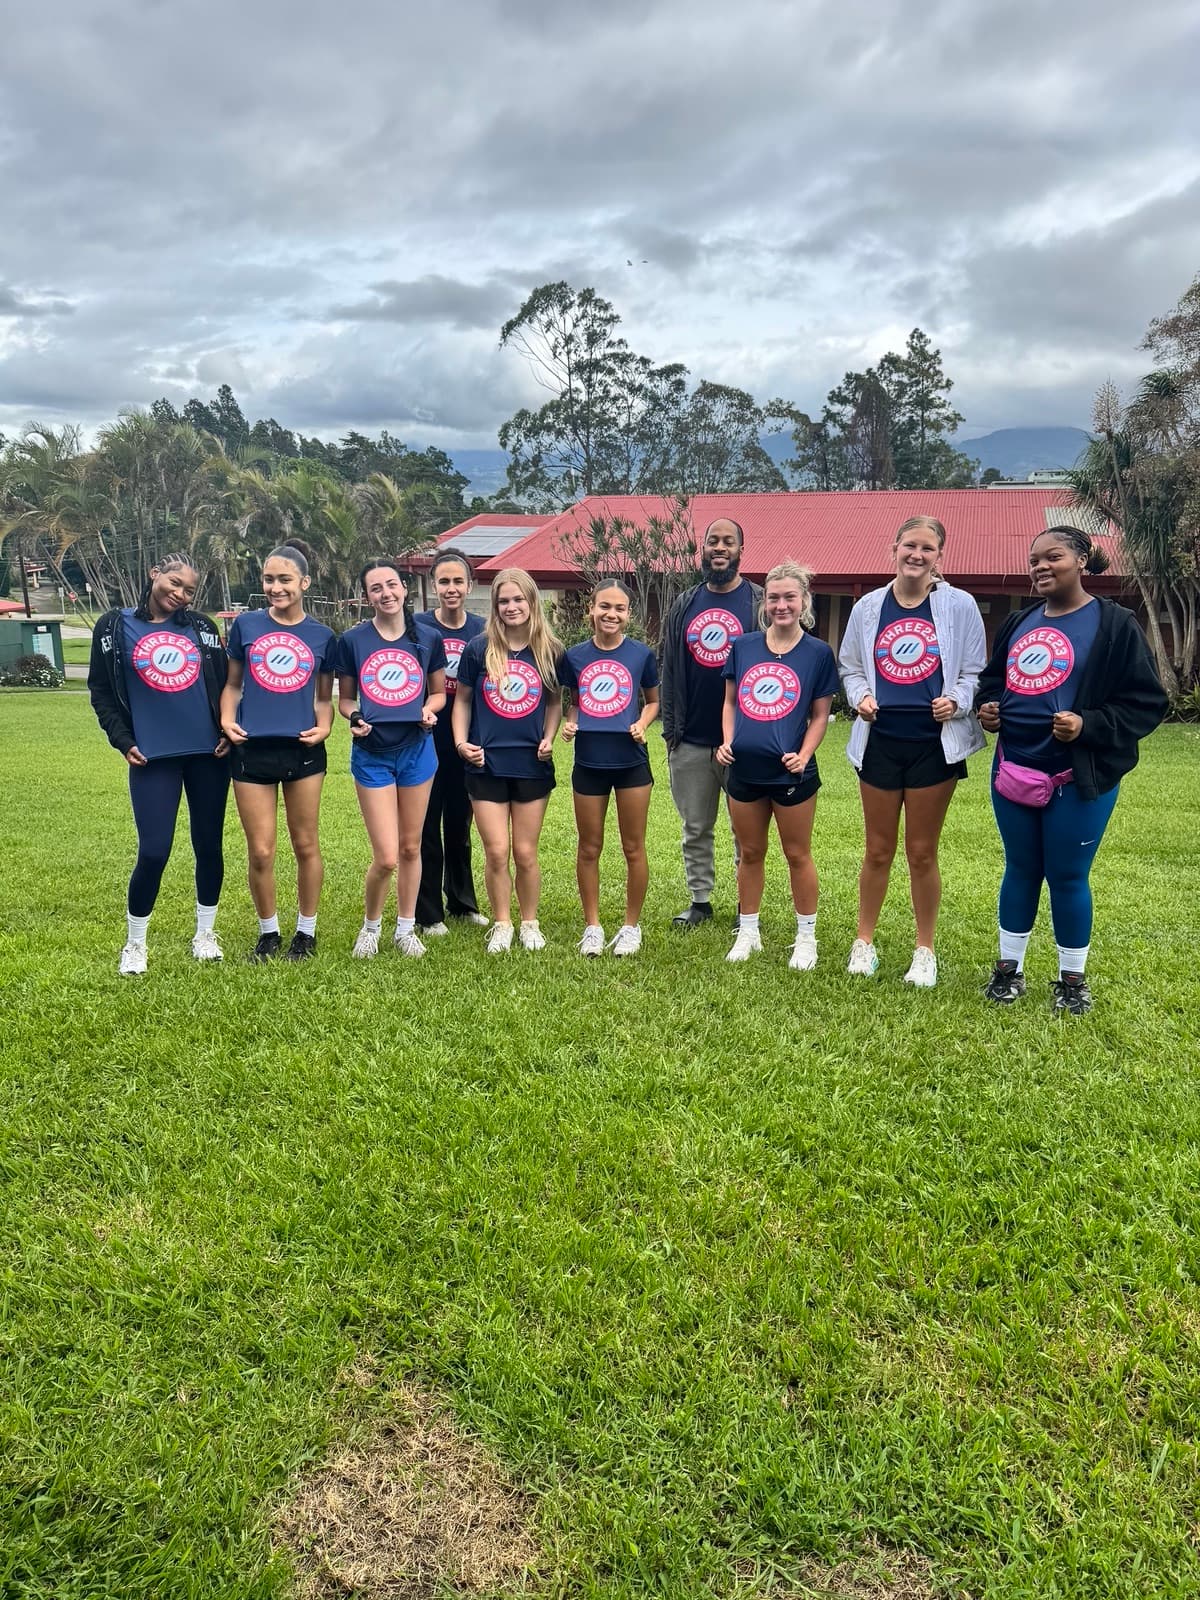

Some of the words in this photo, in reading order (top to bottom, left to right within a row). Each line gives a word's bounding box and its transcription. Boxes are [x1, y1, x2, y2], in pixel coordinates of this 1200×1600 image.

[691, 611, 738, 632] THREE23
[880, 622, 937, 645] THREE23
[1013, 631, 1068, 656] THREE23
[138, 635, 193, 657] THREE23
[254, 635, 310, 658] THREE23
[365, 652, 418, 673] THREE23
[582, 663, 629, 683] THREE23
[881, 656, 937, 678] VOLLEYBALL
[144, 664, 198, 686] VOLLEYBALL
[255, 664, 307, 686] VOLLEYBALL
[510, 663, 538, 685] EE23
[744, 665, 797, 688] THREE23
[1008, 668, 1062, 688] VOLLEYBALL
[368, 682, 418, 700] VOLLEYBALL
[489, 691, 537, 712] VOLLEYBALL
[582, 694, 626, 711] VOLLEYBALL
[743, 694, 793, 715] VOLLEYBALL
